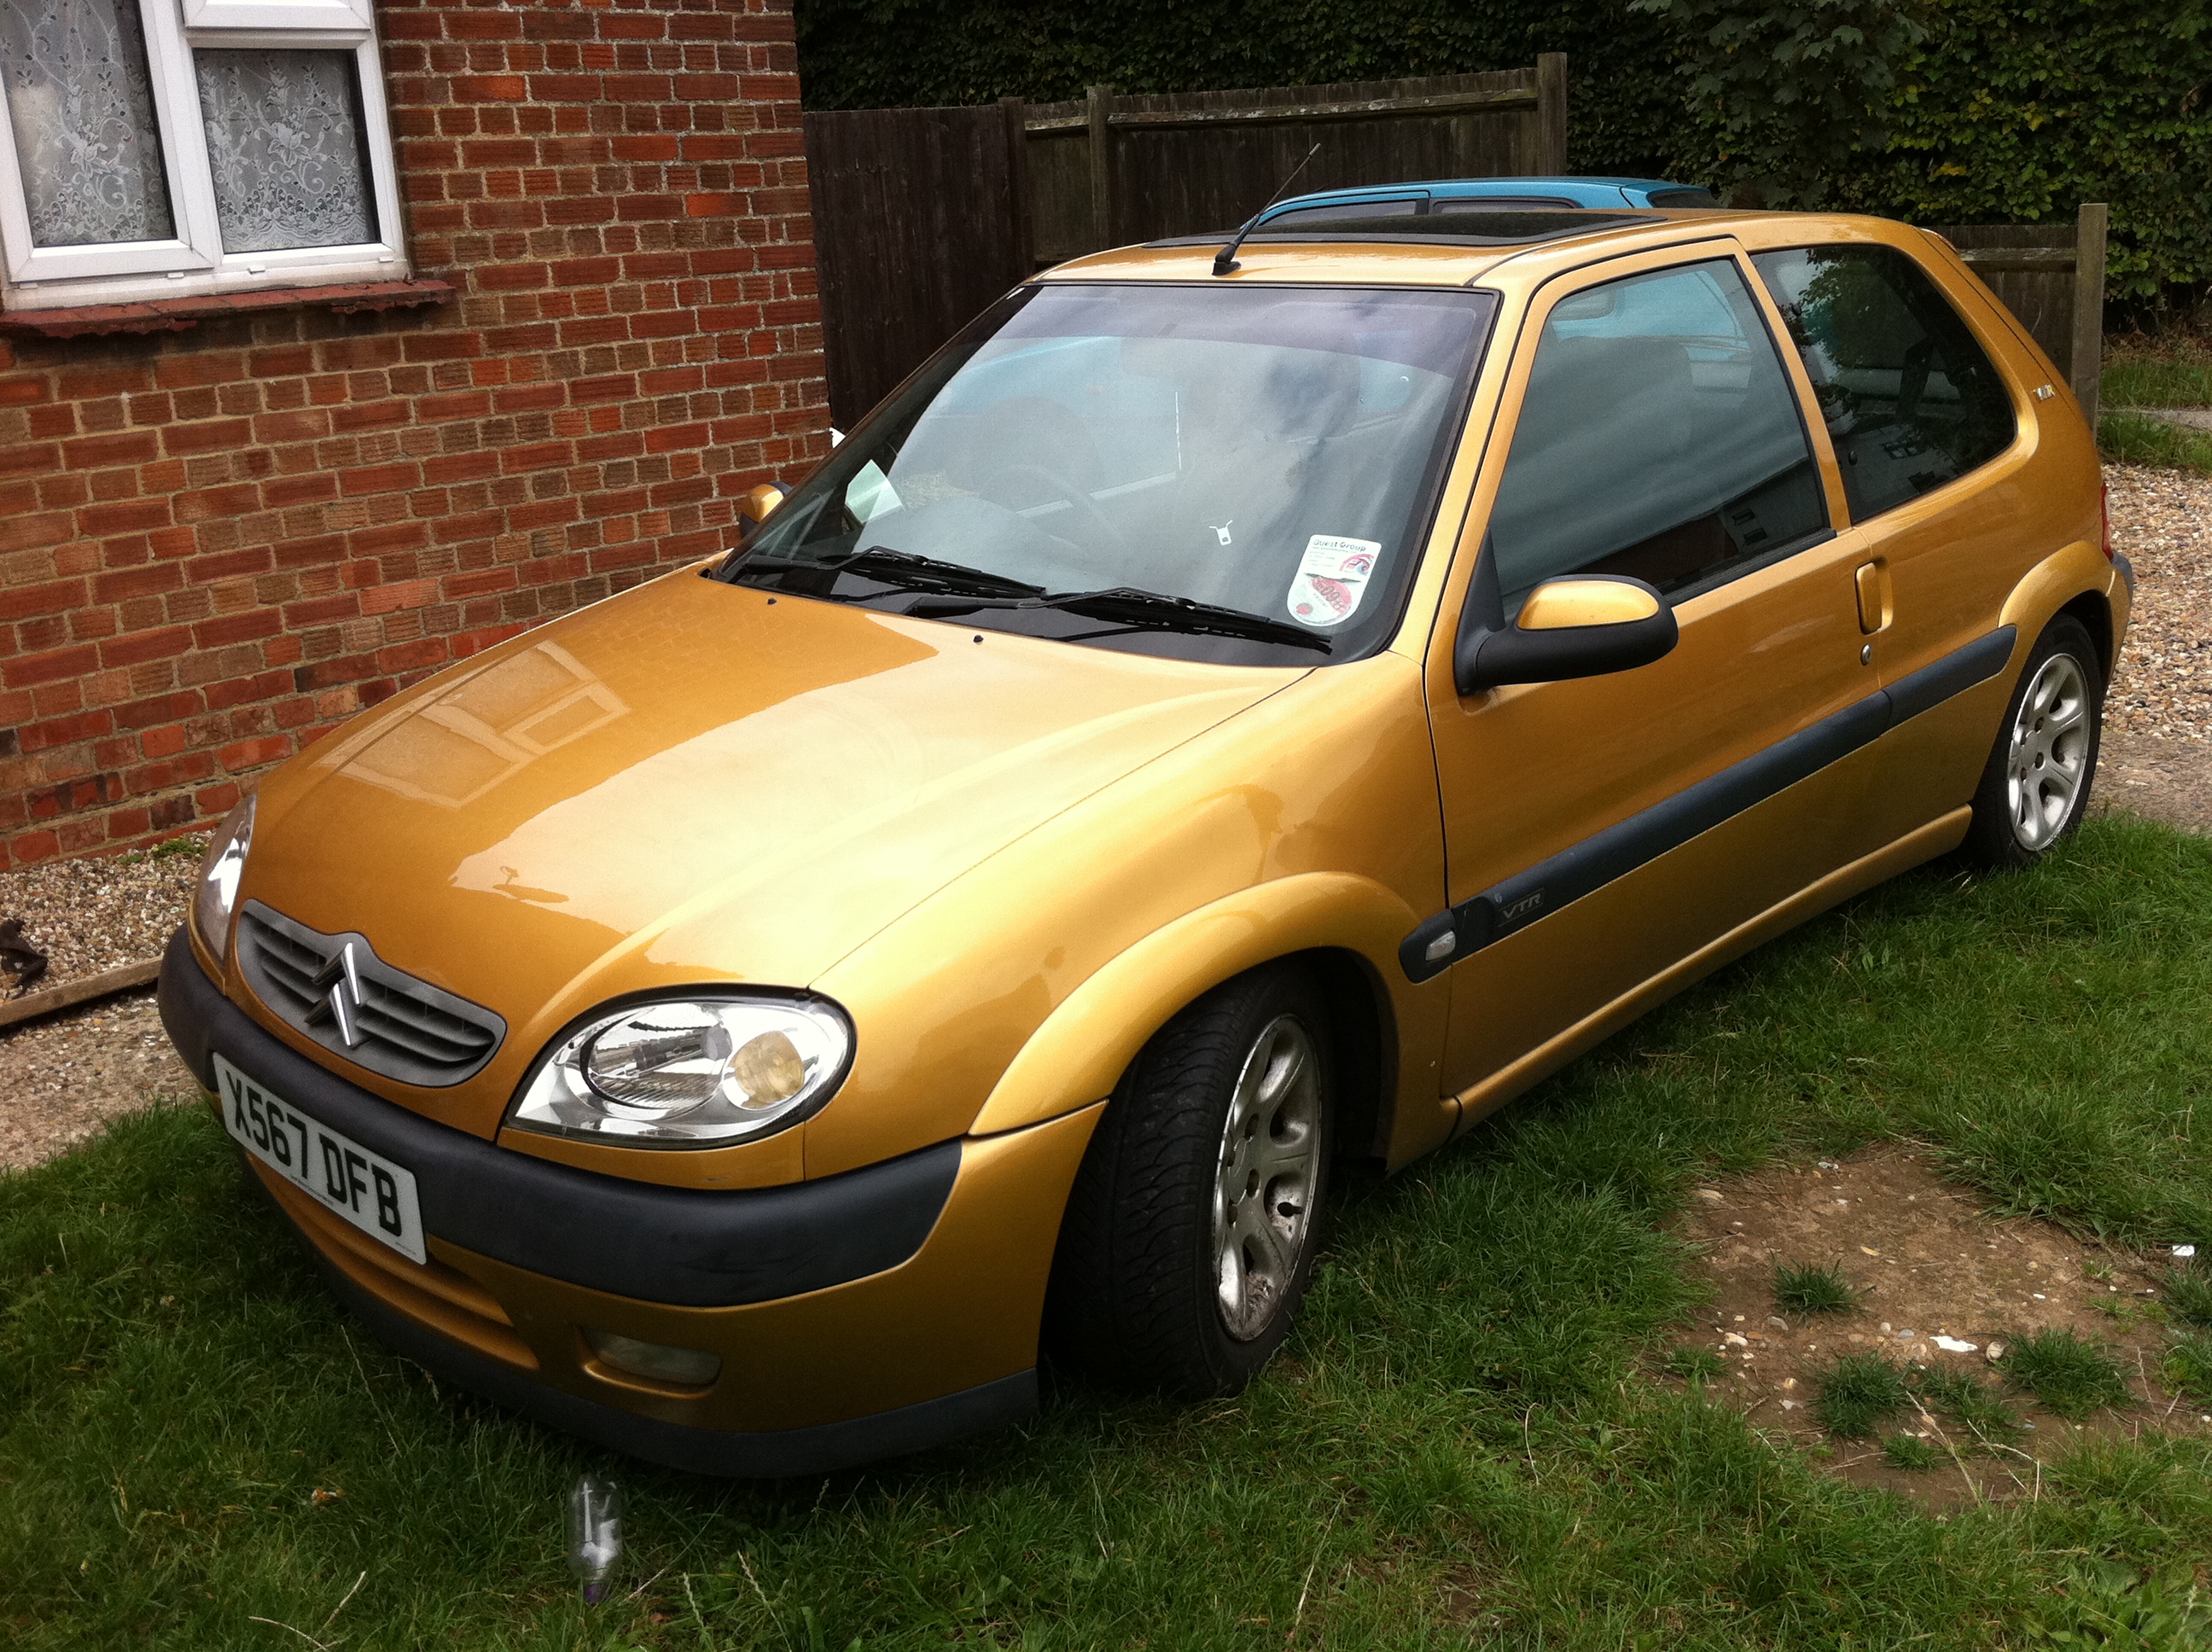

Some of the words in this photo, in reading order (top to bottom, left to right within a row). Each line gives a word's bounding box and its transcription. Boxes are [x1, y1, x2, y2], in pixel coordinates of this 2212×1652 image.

[1340, 541, 1367, 553] Group
[1502, 893, 1541, 919] VTR
[225, 1069, 308, 1180] X567
[318, 1131, 402, 1237] DFB
